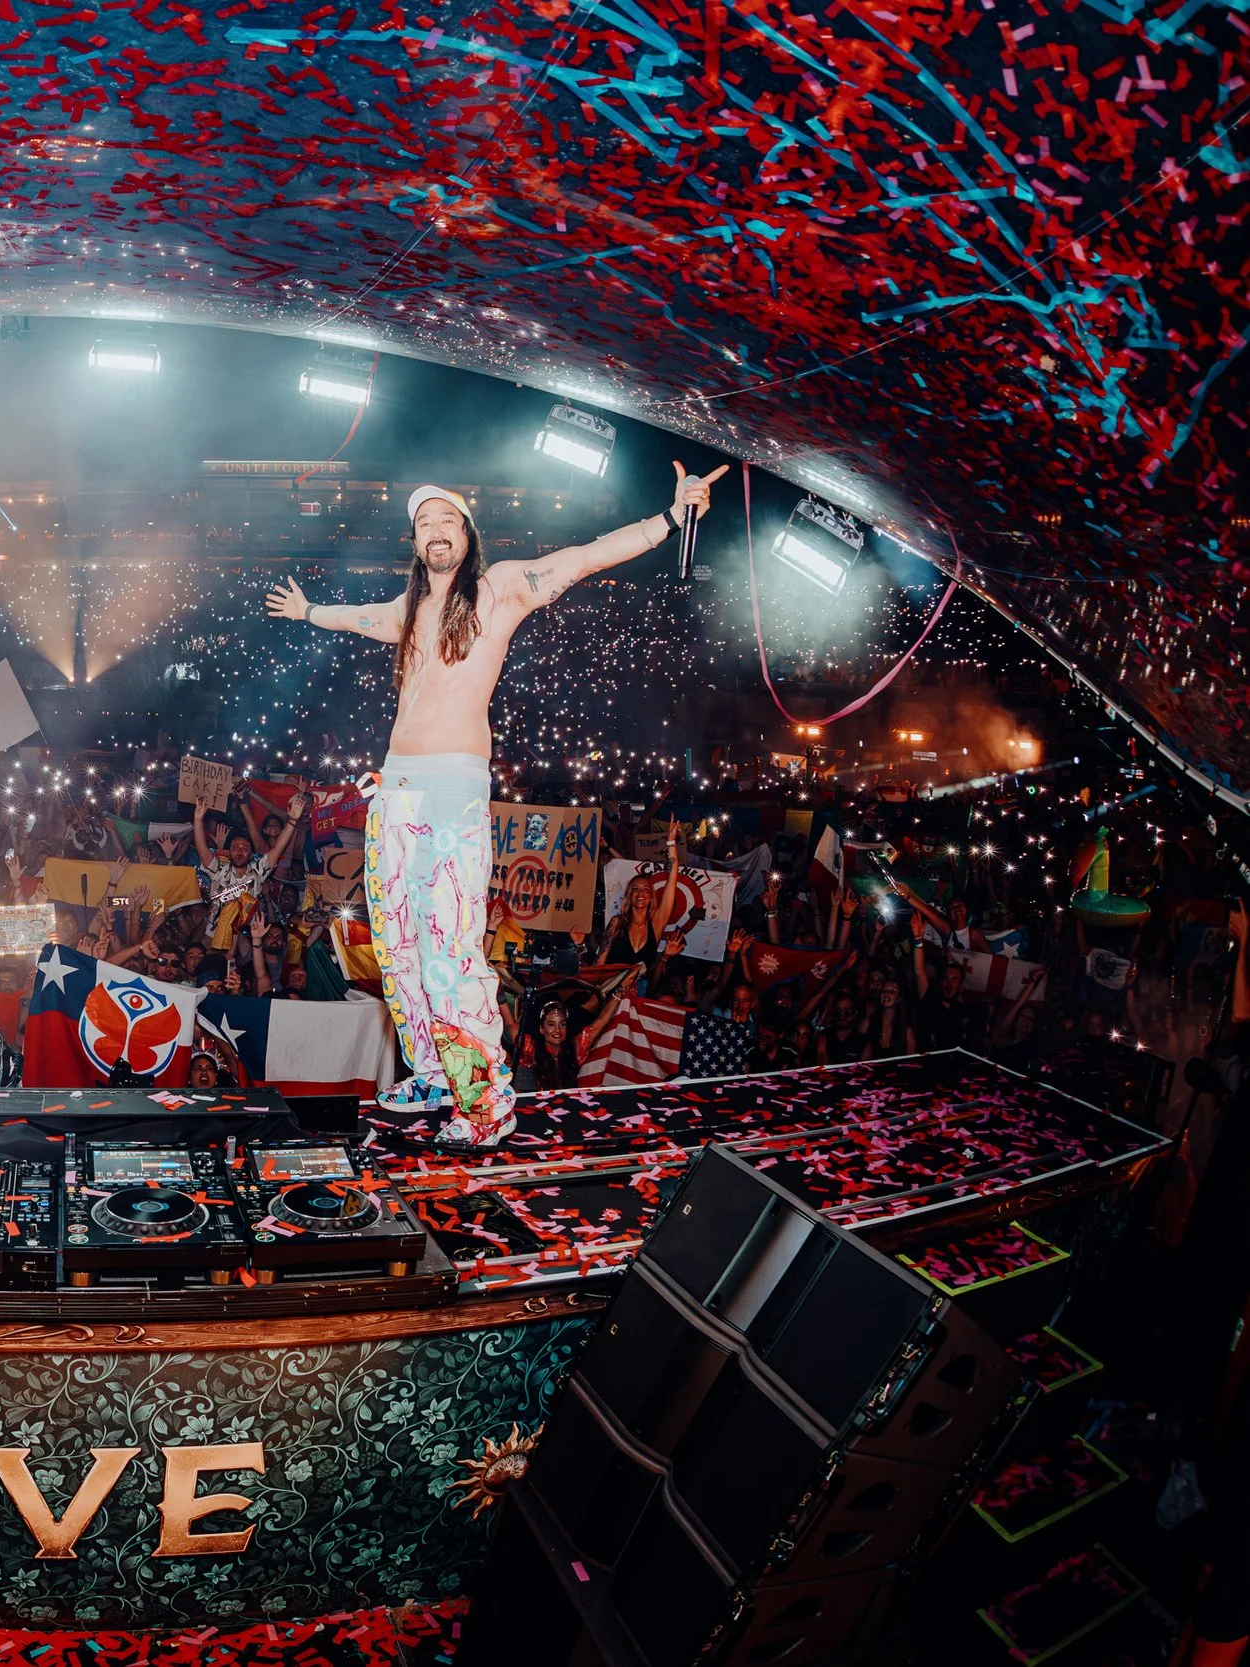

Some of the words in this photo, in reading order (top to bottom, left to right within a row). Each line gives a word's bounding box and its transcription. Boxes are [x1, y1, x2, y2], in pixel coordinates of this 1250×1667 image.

[225, 463, 269, 473] UNITE
[274, 463, 337, 473] FOREVER
[181, 758, 230, 782] BIRTHDAY
[183, 776, 224, 797] CAKE
[549, 812, 597, 867] AOKI
[517, 866, 574, 889] TARGET
